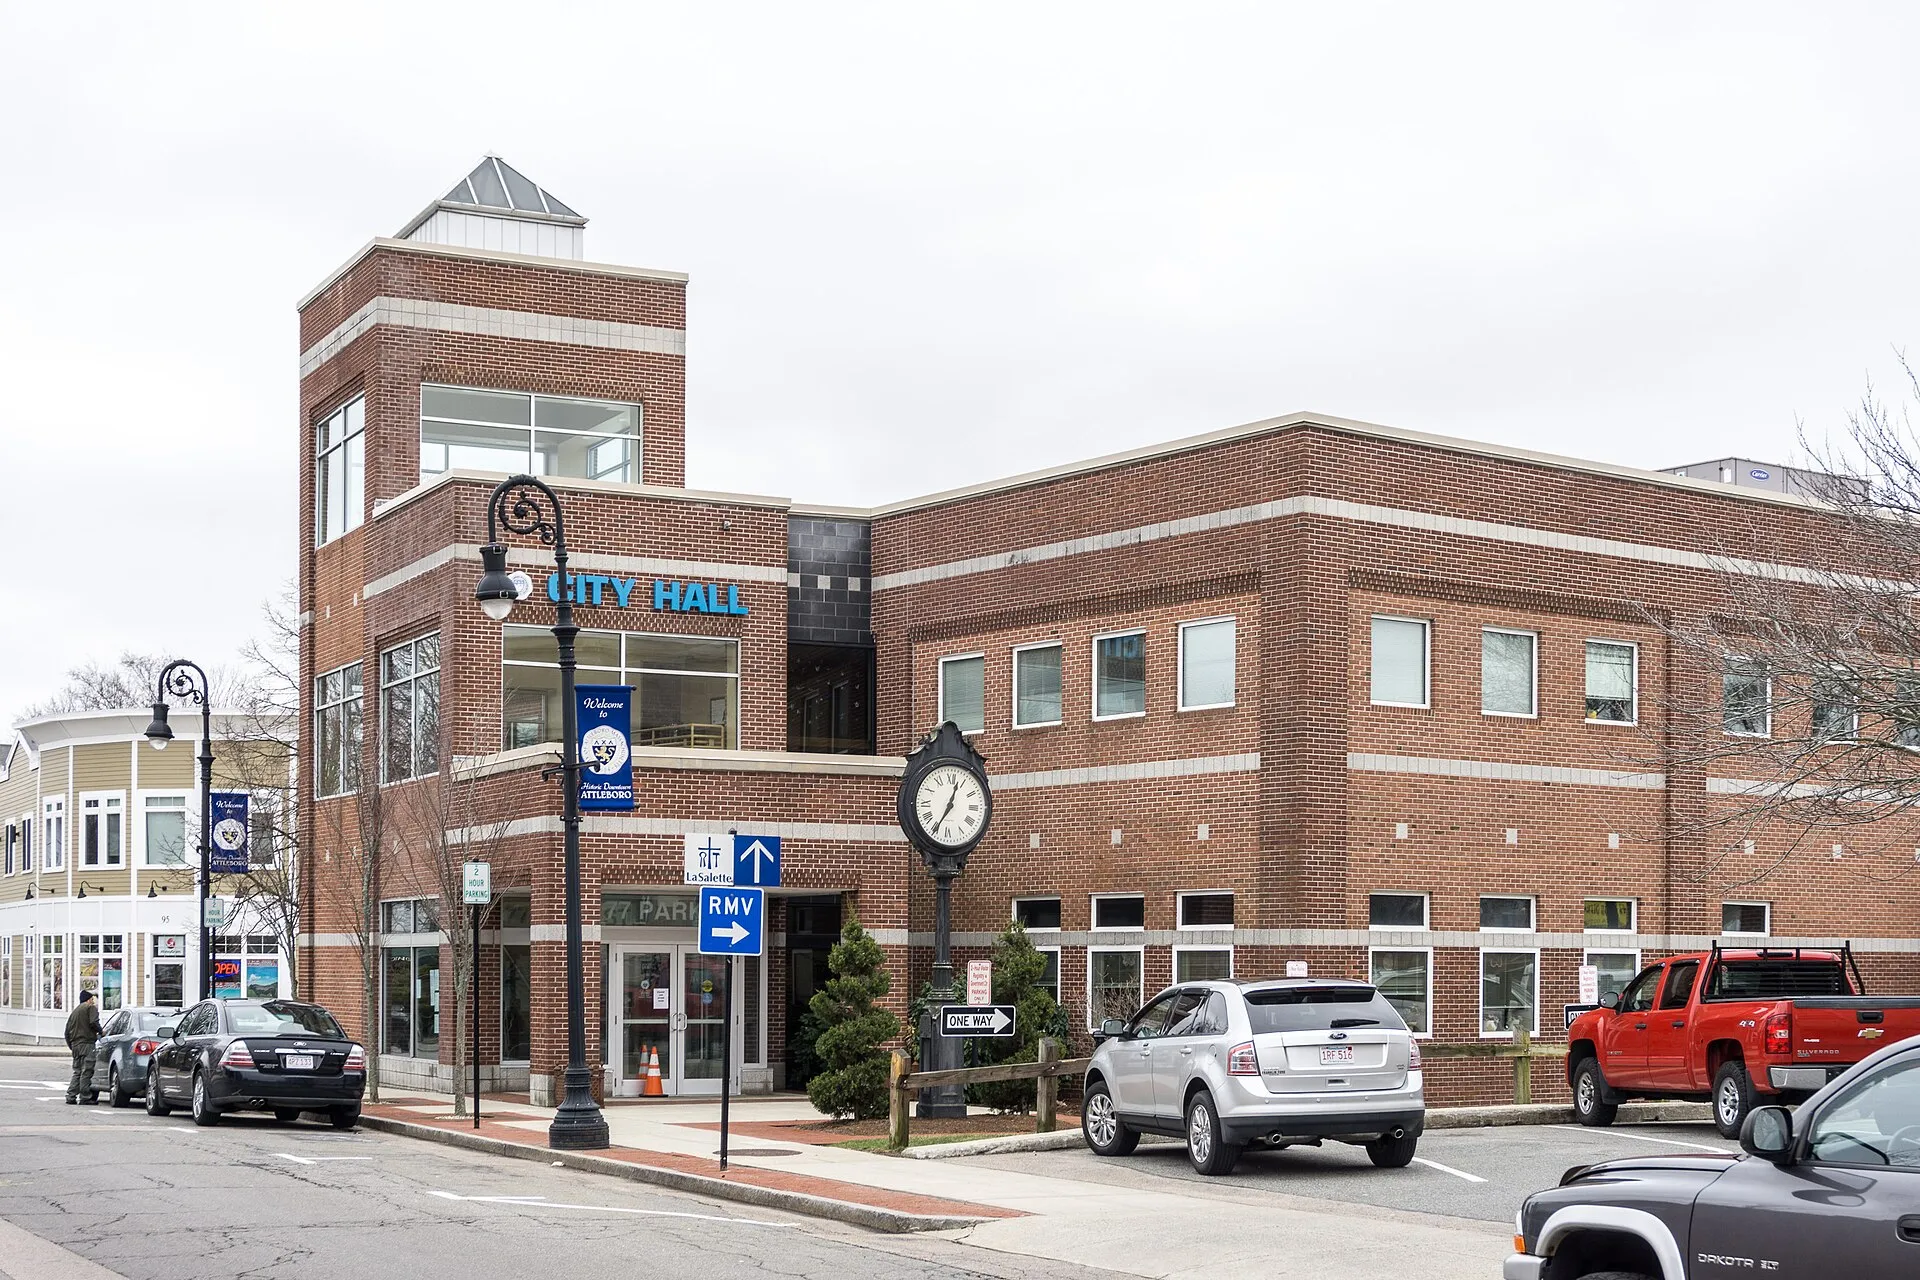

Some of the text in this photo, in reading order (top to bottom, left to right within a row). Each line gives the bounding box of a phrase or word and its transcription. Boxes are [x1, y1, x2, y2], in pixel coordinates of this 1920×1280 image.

[548, 571, 636, 608] CITY
[654, 580, 749, 615] HALL
[584, 698, 623, 709] Welcome
[581, 790, 632, 799] ATTLEBORO
[216, 800, 243, 808] Welcome
[686, 872, 732, 883] LaSalette
[606, 901, 698, 920] 77 PARK
[709, 896, 754, 916] RMV
[215, 963, 240, 974] OPEN
[950, 1016, 993, 1026] ONE WAY
[1322, 1050, 1352, 1060] 1RF 516
[1698, 1253, 1754, 1268] DAKOTA
